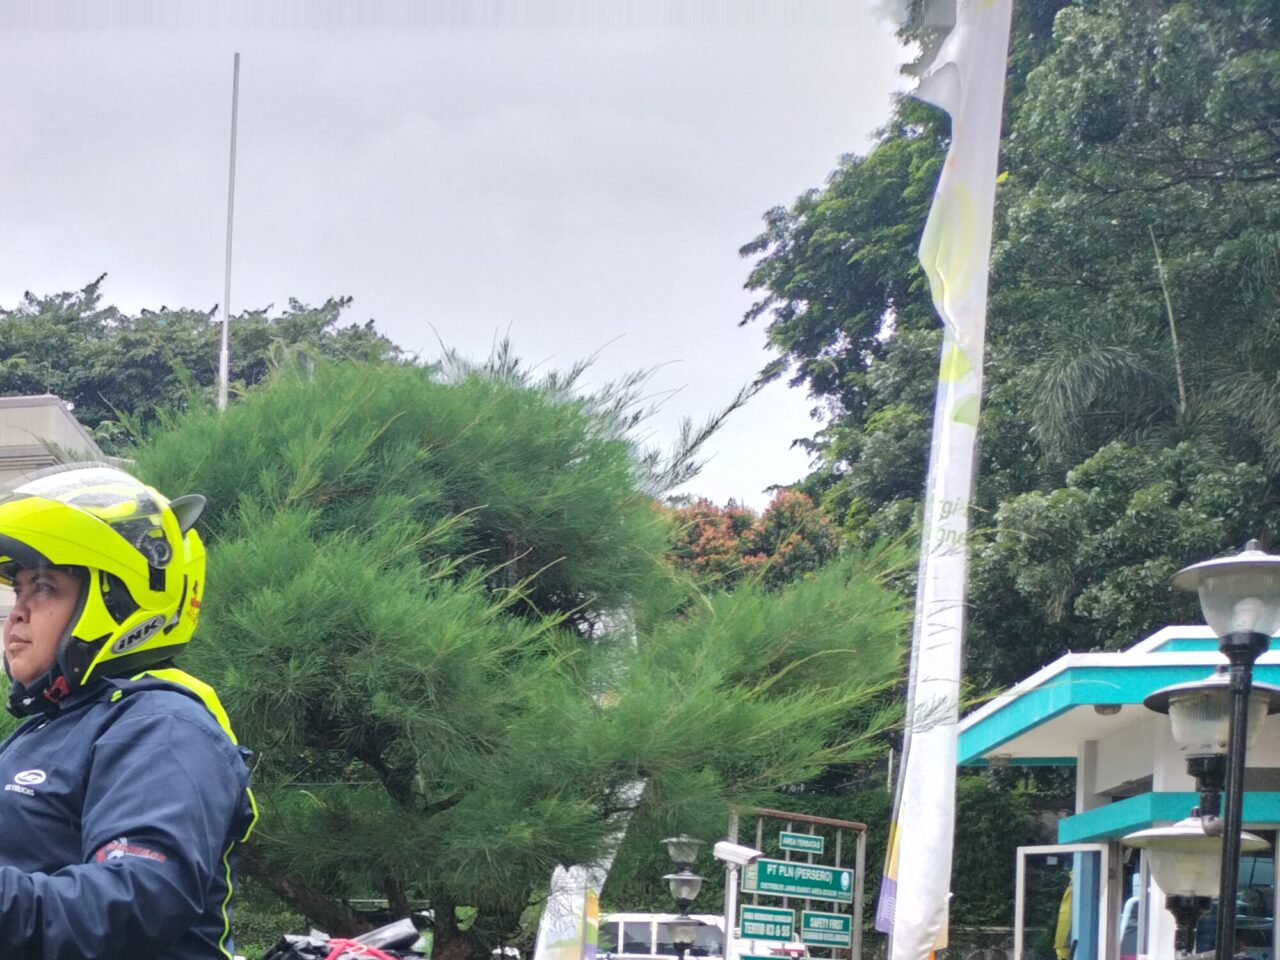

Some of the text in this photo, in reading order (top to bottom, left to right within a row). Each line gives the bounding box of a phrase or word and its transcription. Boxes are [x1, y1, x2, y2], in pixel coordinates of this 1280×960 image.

[118, 618, 159, 650] INK
[767, 864, 833, 884] PT PLN (PERSERO)
